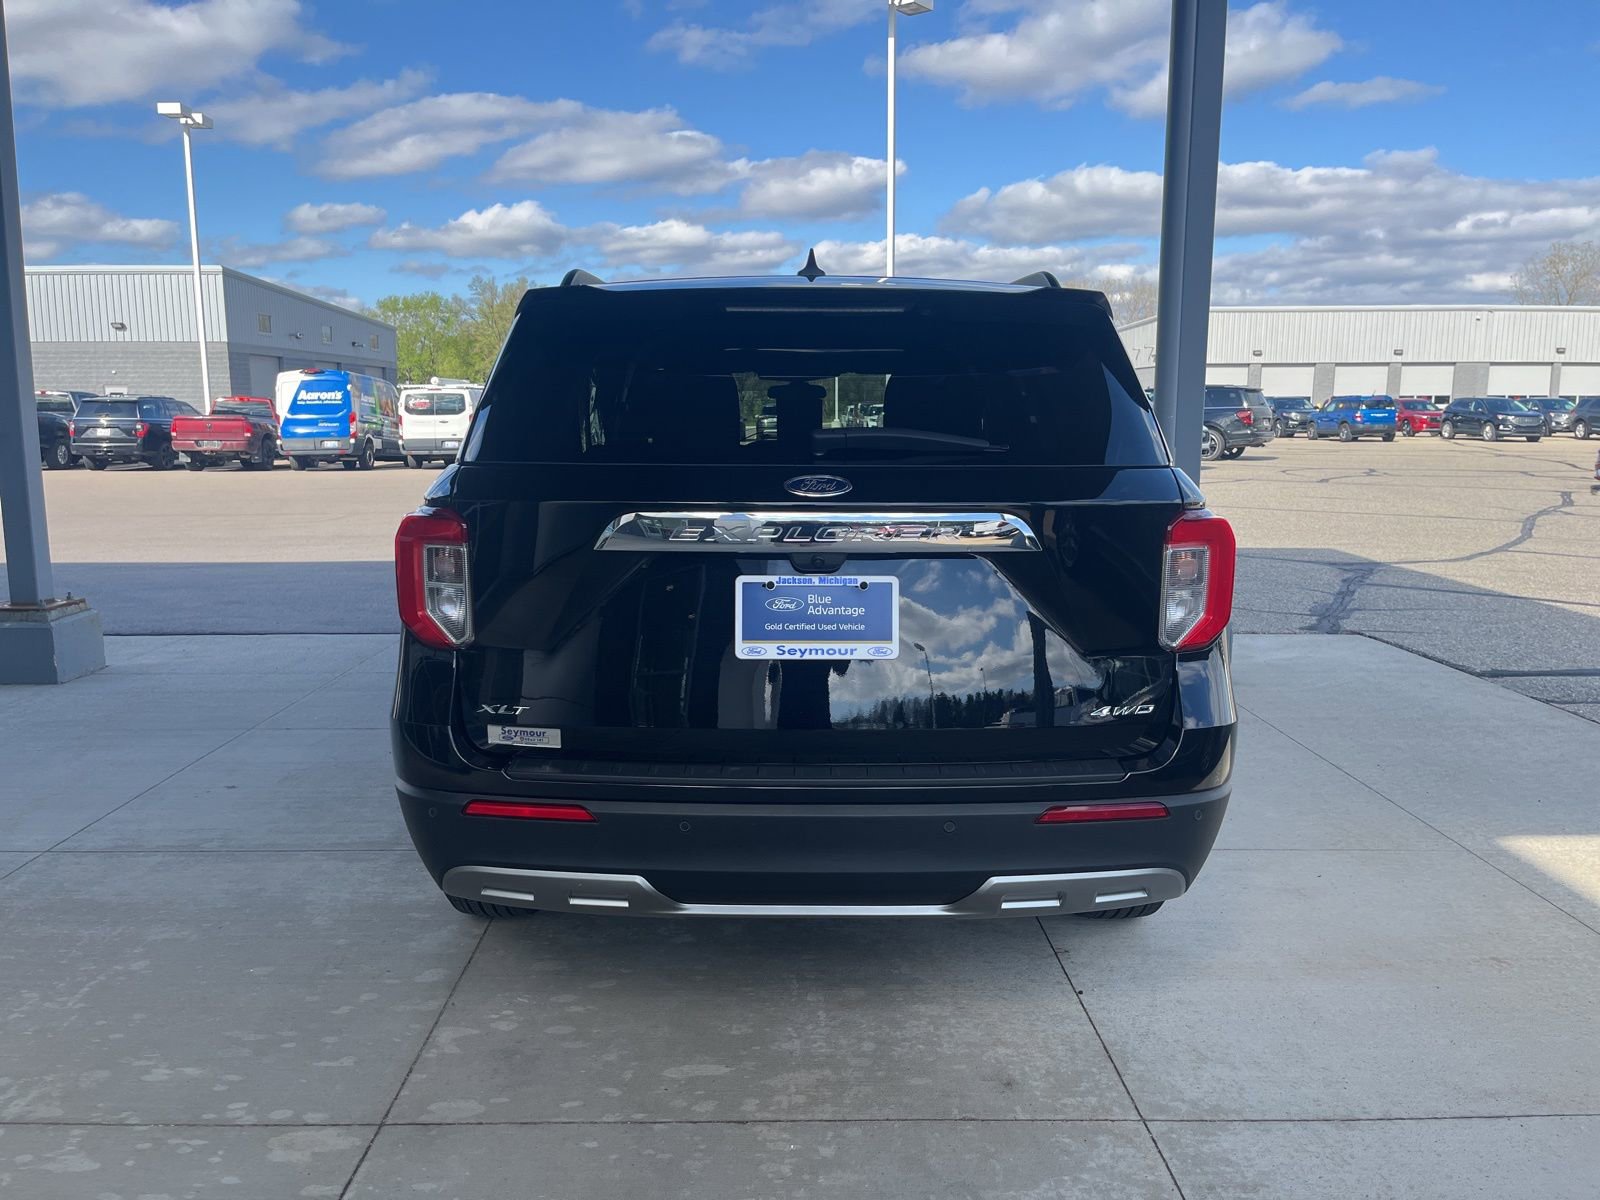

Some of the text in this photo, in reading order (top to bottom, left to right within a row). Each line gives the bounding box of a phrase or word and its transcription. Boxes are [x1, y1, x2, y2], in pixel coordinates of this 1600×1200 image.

[297, 390, 342, 400] Aaron's
[669, 525, 962, 542] EXPLORER
[818, 577, 858, 586] Michigan
[808, 594, 832, 604] Blue
[807, 606, 866, 617] Advantage
[765, 623, 866, 631] Gold Certified Used Vehicle
[776, 645, 858, 658] Seymour
[476, 704, 530, 715] XLT
[1090, 704, 1155, 717] 4WD
[501, 726, 547, 738] Seymour
